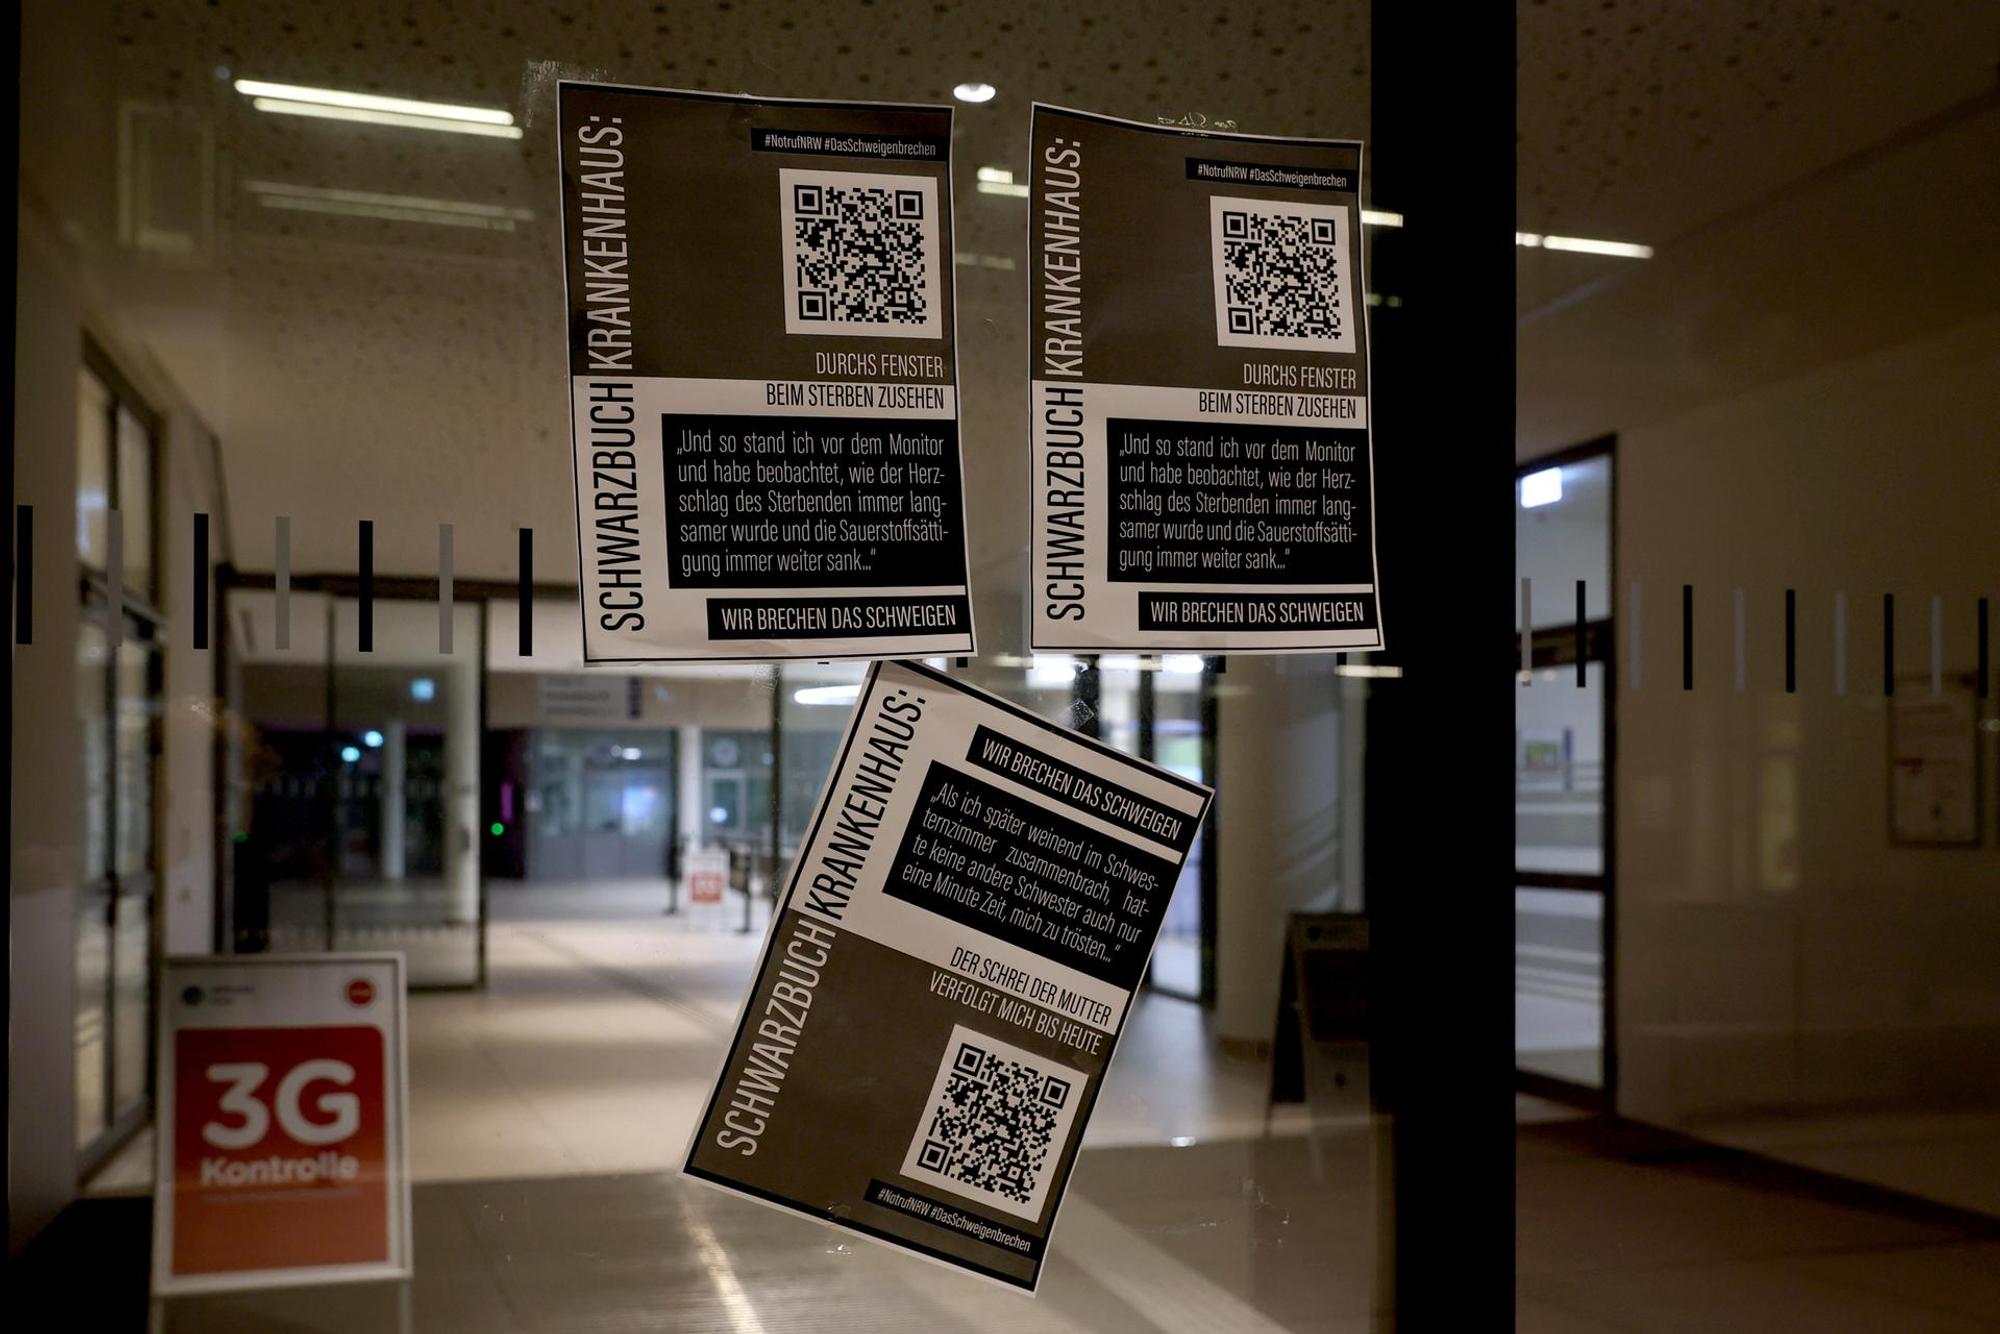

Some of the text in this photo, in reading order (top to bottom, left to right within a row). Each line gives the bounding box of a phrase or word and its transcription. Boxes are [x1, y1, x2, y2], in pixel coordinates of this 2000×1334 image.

[765, 134, 936, 156] #NotrufNRW #DasSchweigenbrechen
[1198, 164, 1347, 188] #NotrufNRW #DasSchweigenbrechen
[578, 115, 644, 631] SCHWARZBUCH KRANKENHAUS:
[817, 352, 943, 378] DURCHS FENSTER
[1244, 363, 1356, 389] DURCHS FENSTER
[1045, 138, 1085, 620] SCHWARZBUCH KRANKENHAUS:
[767, 384, 943, 409] BEIM STERBEN ZUSEHEN
[1200, 392, 1356, 418] BEIM STERBEN ZUSEHEN
[720, 437, 736, 453] so
[744, 431, 784, 453] stand
[793, 432, 814, 454] ich
[821, 439, 845, 454] vor
[851, 433, 881, 455] dem
[890, 433, 944, 455] Monitor
[1156, 440, 1171, 456] so
[1177, 436, 1213, 458] stand
[1221, 437, 1239, 458] ich
[1245, 443, 1265, 459] vor
[1272, 438, 1298, 461] dem
[1306, 440, 1355, 462] Monitor
[679, 460, 945, 486] und habe beobachtet, wie der Herz-
[1120, 463, 1355, 489] und habe beobachtet, wie der Herz-
[680, 490, 946, 517] schlag des Sterbenden immer lang-
[1120, 490, 1356, 520] schlag des Sterbenden immer lang-
[680, 519, 948, 542] samer wurde und die Sauerstoffsätti-
[1120, 519, 1357, 542] samer wurde und die Sauerstoffsätti-
[682, 554, 720, 577] gung
[726, 551, 771, 572] immer
[778, 550, 823, 572] weiter
[1120, 550, 1152, 572] gung
[1157, 547, 1198, 568] immer
[1202, 548, 1242, 568] weiter
[722, 605, 955, 630] WIR BRECHEN DAS SCHWEIGEN
[1151, 602, 1363, 622] WIR BRECHEN DAS SCHWEIGEN
[983, 738, 1181, 840] WIR BRECHEN DAS SCHWEIGEN
[961, 791, 981, 817] ich
[983, 805, 1025, 836] später
[1028, 825, 1080, 859] weinend
[1085, 844, 1102, 867] im
[1104, 853, 1158, 891] Schwes-
[923, 808, 1149, 917] ternzimmer zusammenbrach, hat-
[903, 865, 932, 890] eine
[934, 873, 980, 908] Minute
[982, 893, 1006, 923] Zeit,
[1010, 903, 1042, 932] mich
[1043, 919, 1060, 940] zu
[914, 836, 1141, 944] te keine andere Schwester auch nur
[716, 690, 925, 1156] SCHWARZBUCH KRANKENHAUS:
[951, 946, 1111, 1027] DER SCHREI DER MUTTER
[930, 971, 1102, 1055] VERFOLGT MICH BIS HEUTE
[202, 1058, 360, 1148] 3G
[202, 1151, 358, 1186] Kontrolle
[878, 1188, 1030, 1252] #NotrufNRW #DasSchweigenbrechen
